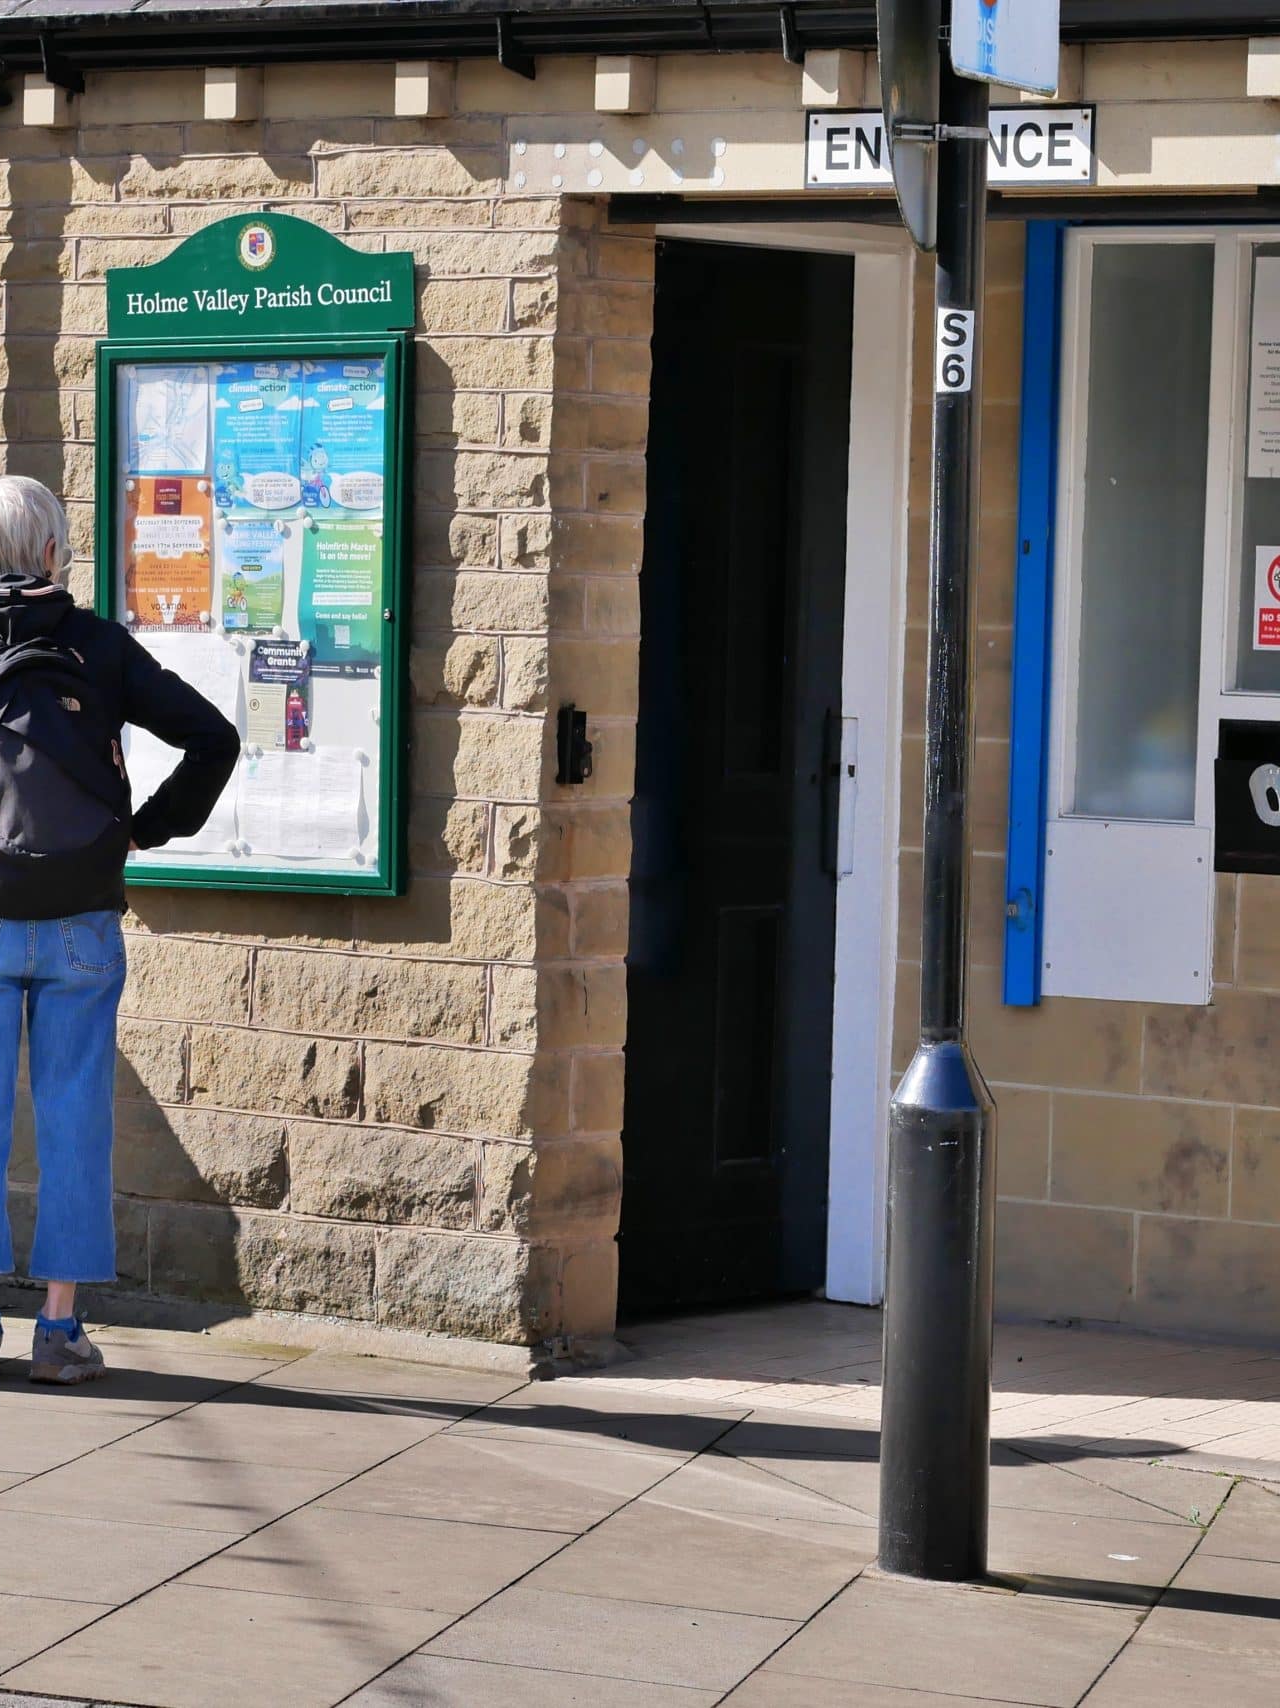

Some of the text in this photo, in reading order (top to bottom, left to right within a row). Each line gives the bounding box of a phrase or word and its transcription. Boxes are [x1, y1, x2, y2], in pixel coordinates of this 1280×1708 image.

[825, 122, 1074, 171] ENNCE
[126, 279, 392, 315] Holme Valley Parish Council
[228, 382, 287, 393] climate action
[317, 381, 377, 393] climate action
[316, 541, 349, 551] Holmfirth
[151, 603, 188, 611] VOCATION
[267, 656, 297, 667] Grants
